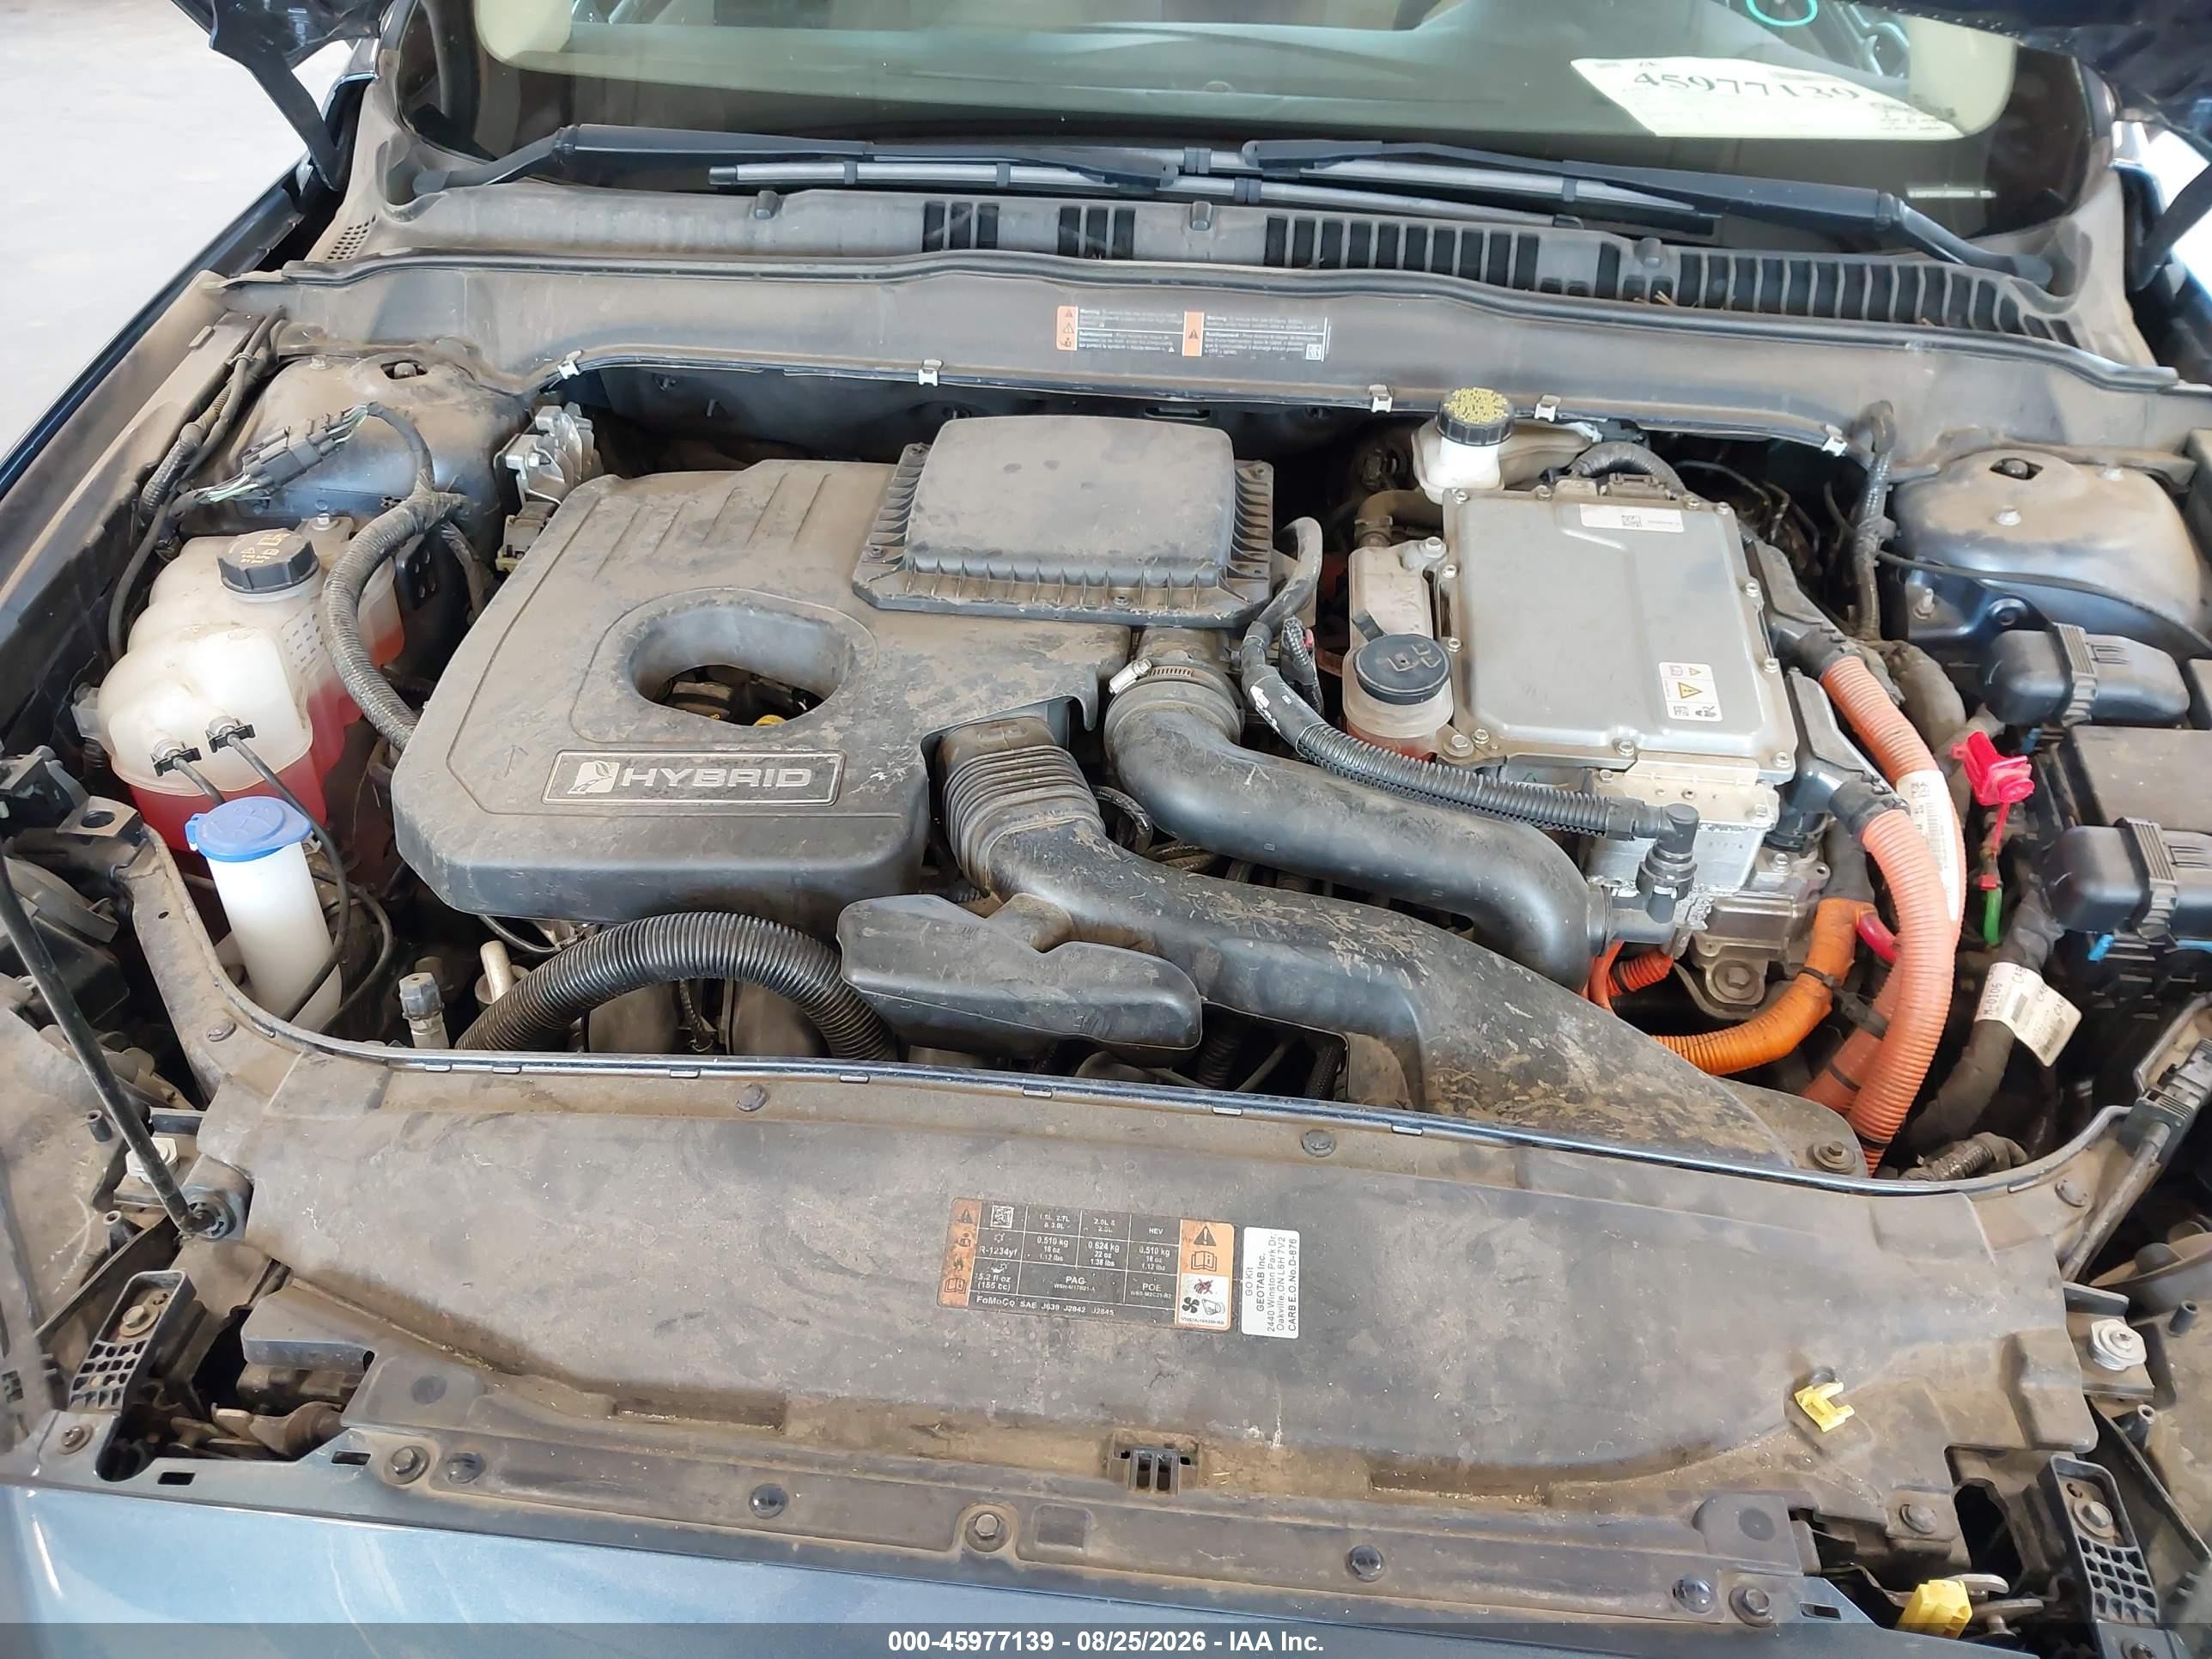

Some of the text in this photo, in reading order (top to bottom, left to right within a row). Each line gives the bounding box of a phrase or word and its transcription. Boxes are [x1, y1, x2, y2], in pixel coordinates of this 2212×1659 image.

[1633, 72, 1861, 100] 45977139
[620, 768, 812, 788] HYBRID
[980, 1245, 1018, 1257] R-1234yf
[1037, 1237, 1069, 1248] 0.510 kg
[1088, 1241, 1120, 1253] 0.624 kg
[1139, 1245, 1170, 1257] 0.510 kg
[1267, 1249, 1276, 1269] Park
[1065, 1275, 1085, 1285] PAG
[1142, 1282, 1162, 1292] POE
[1245, 1267, 1254, 1297] GO Kit
[1255, 1253, 1266, 1312] GEOTAB Inc.
[1267, 1272, 1276, 1309] Winston
[976, 1295, 1015, 1307] FoMoCo
[1020, 1300, 1037, 1309] SAE
[1063, 1304, 1086, 1313] J2842
[1288, 1305, 1297, 1331] CARB
